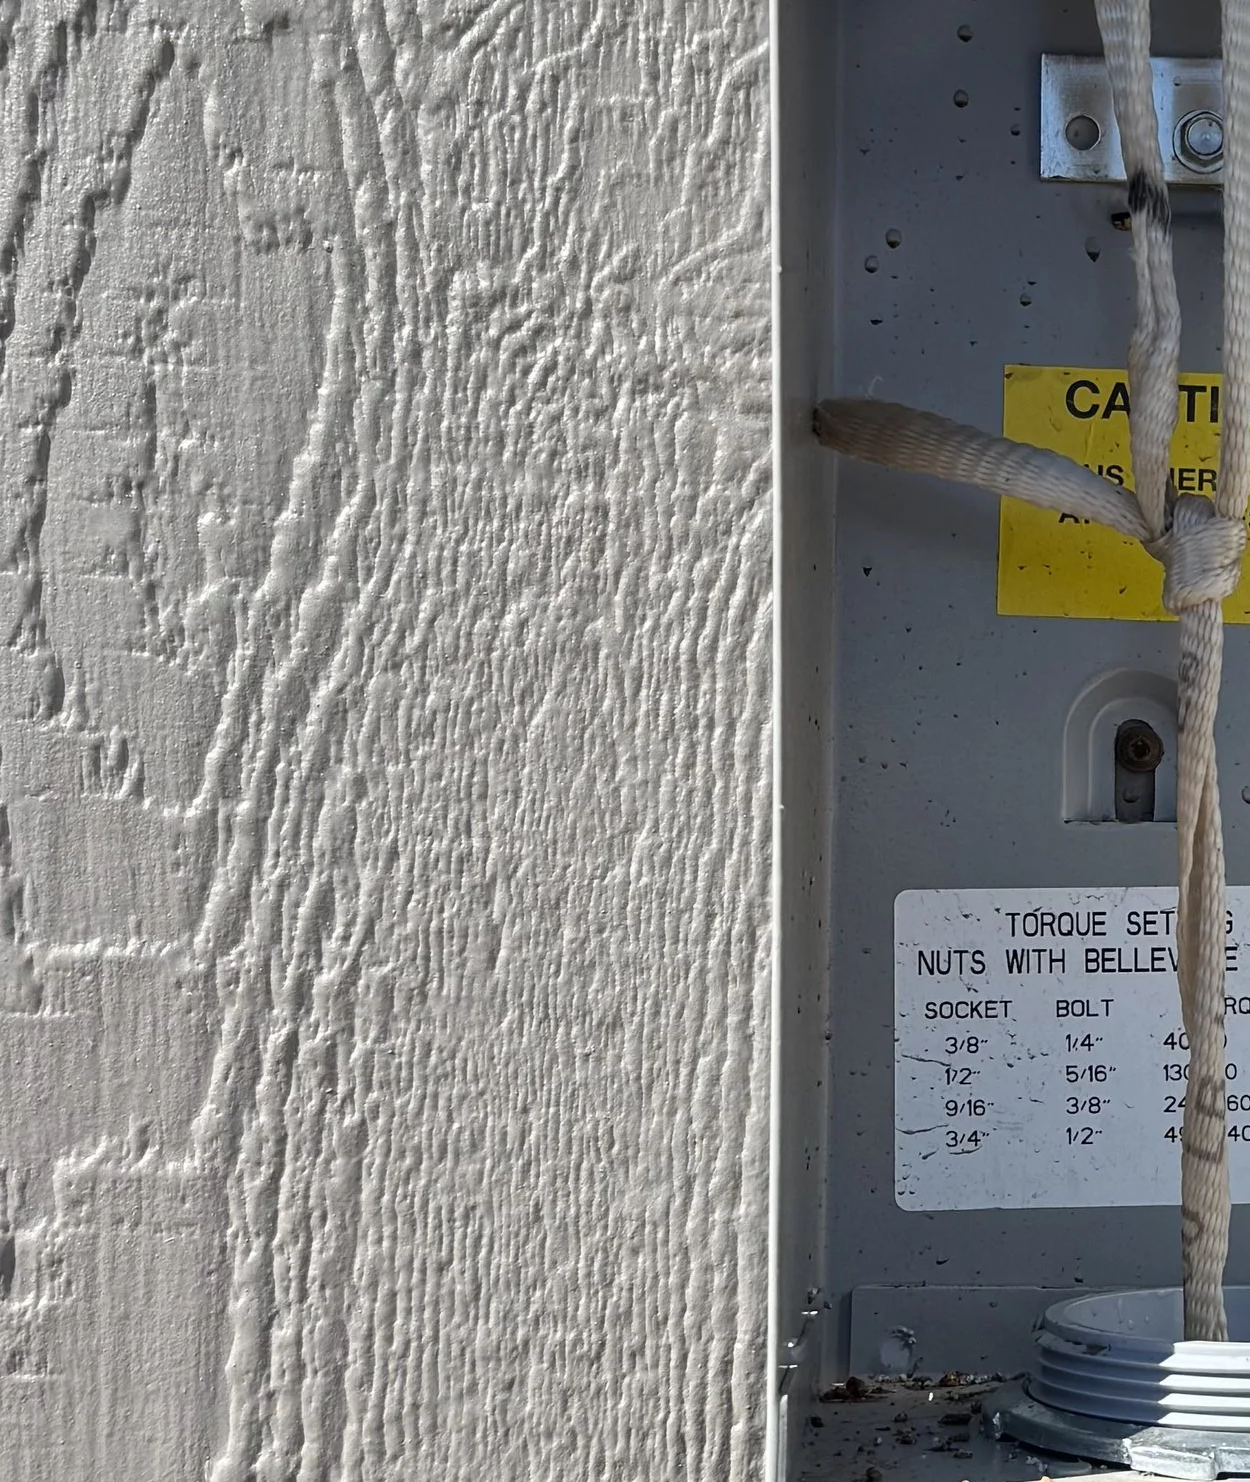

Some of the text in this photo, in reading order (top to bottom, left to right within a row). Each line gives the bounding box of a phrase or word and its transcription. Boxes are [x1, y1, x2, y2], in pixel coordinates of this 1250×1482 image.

[1005, 911, 1107, 937] TORQUE
[917, 950, 986, 976] NUTS
[1005, 948, 1066, 974] WITH
[924, 1000, 1013, 1019] SOCKET
[1056, 999, 1114, 1018] BOLT
[945, 1036, 988, 1054] 3/8"
[1065, 1033, 1103, 1052] 1/4"
[1065, 1064, 1116, 1083] 5/16"
[945, 1099, 994, 1116] 9/16"
[1066, 1097, 1111, 1114] 3/8"
[945, 1130, 990, 1147] 3/4"
[1066, 1127, 1103, 1145] 1/2"
